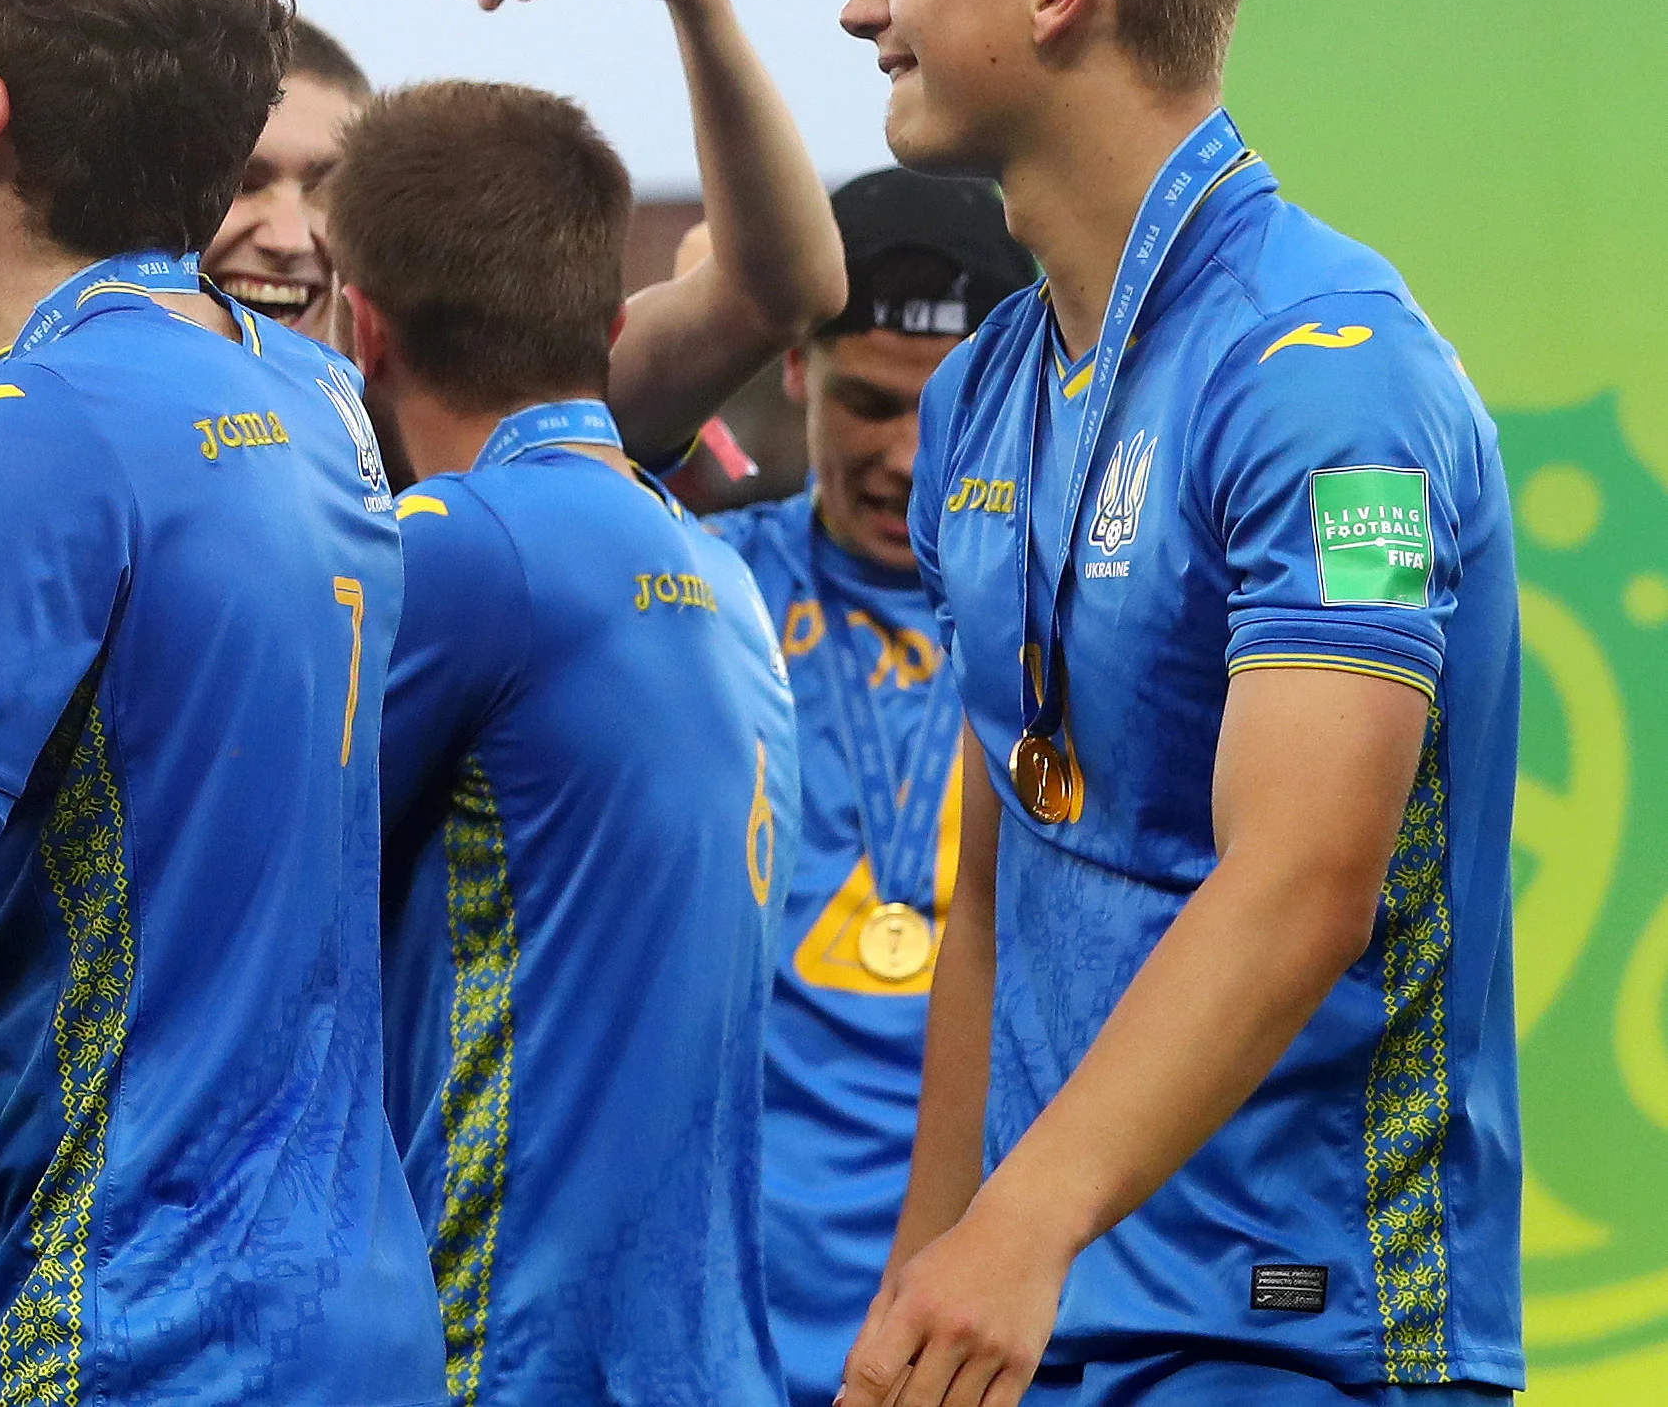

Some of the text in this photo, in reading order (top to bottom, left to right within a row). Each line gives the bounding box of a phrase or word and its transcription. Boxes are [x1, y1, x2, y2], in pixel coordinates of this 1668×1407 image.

[1164, 171, 1192, 205] FIFA
[1137, 225, 1160, 264] FIFA
[137, 261, 170, 276] FIFA
[1115, 283, 1134, 324] FIFA
[1324, 505, 1420, 525] LIVING
[1325, 521, 1423, 540] FOOTBALL
[1085, 561, 1130, 578] UKRAINE
[1388, 550, 1425, 570] FIFA
[333, 576, 363, 768] 7
[747, 740, 774, 908] 6
